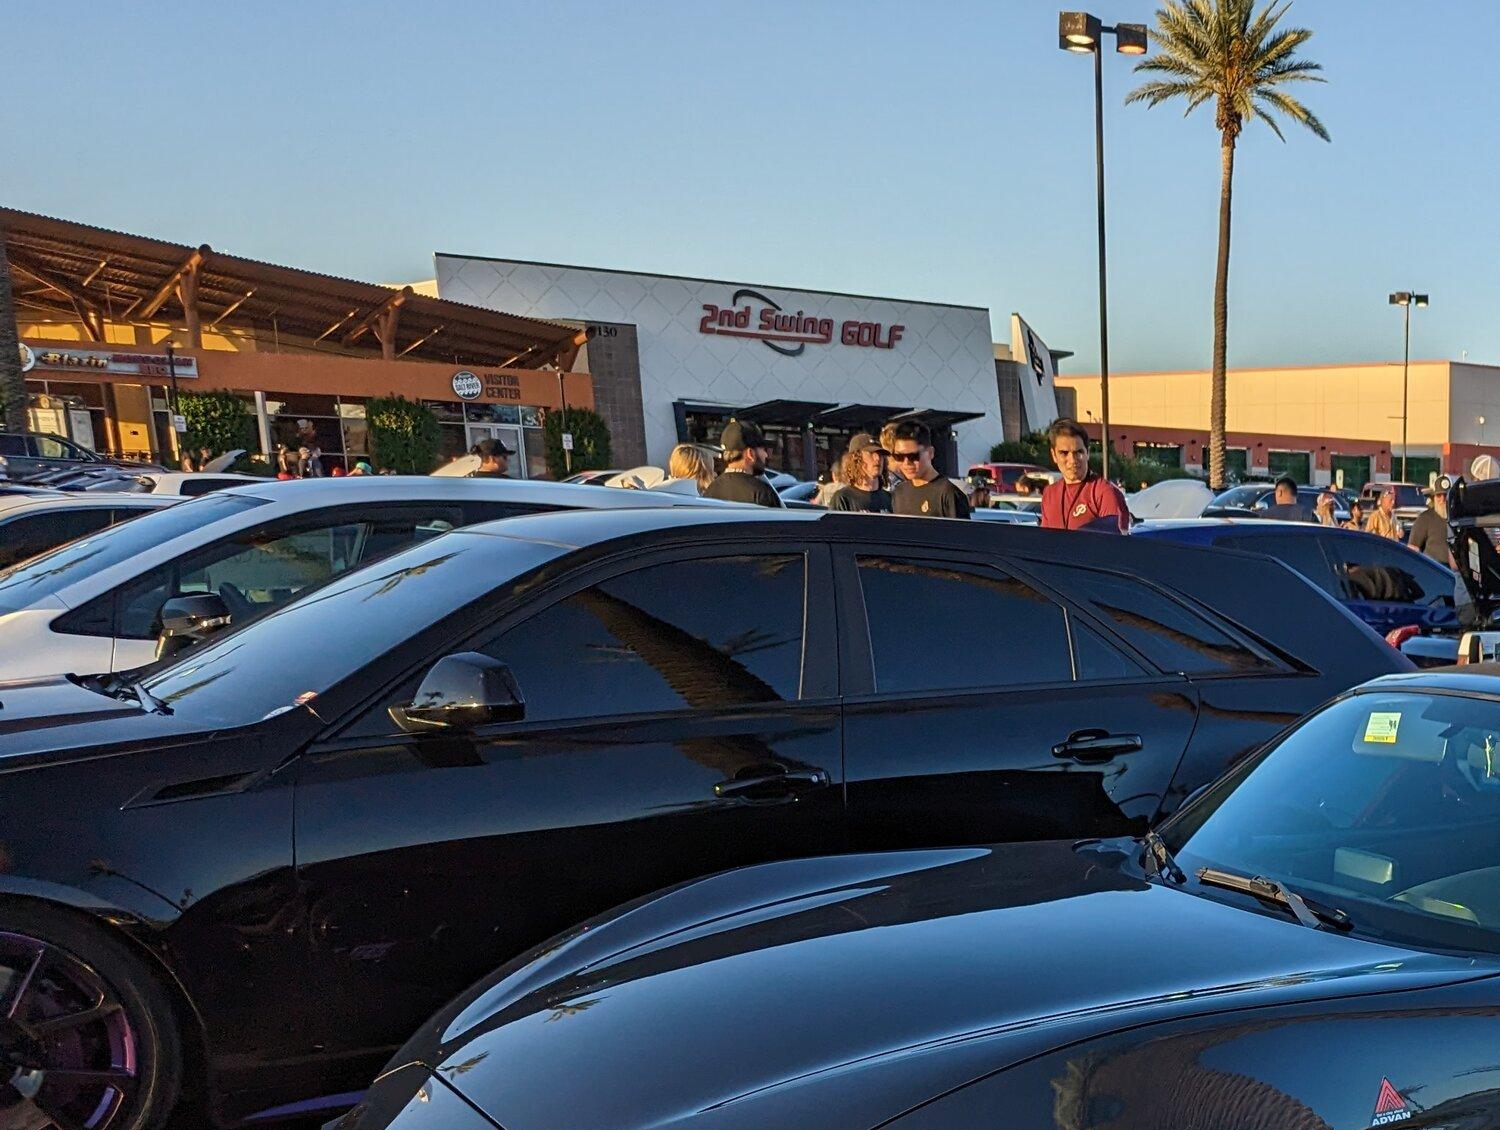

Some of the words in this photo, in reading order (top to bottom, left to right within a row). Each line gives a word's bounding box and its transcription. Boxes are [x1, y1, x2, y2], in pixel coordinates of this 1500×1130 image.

[699, 304, 750, 335] 2nd
[758, 308, 834, 344] Swing
[841, 320, 906, 350] GOLF
[484, 374, 520, 386] VISITOR
[485, 387, 521, 400] CENTER
[1372, 1112, 1410, 1126] ADVAN
